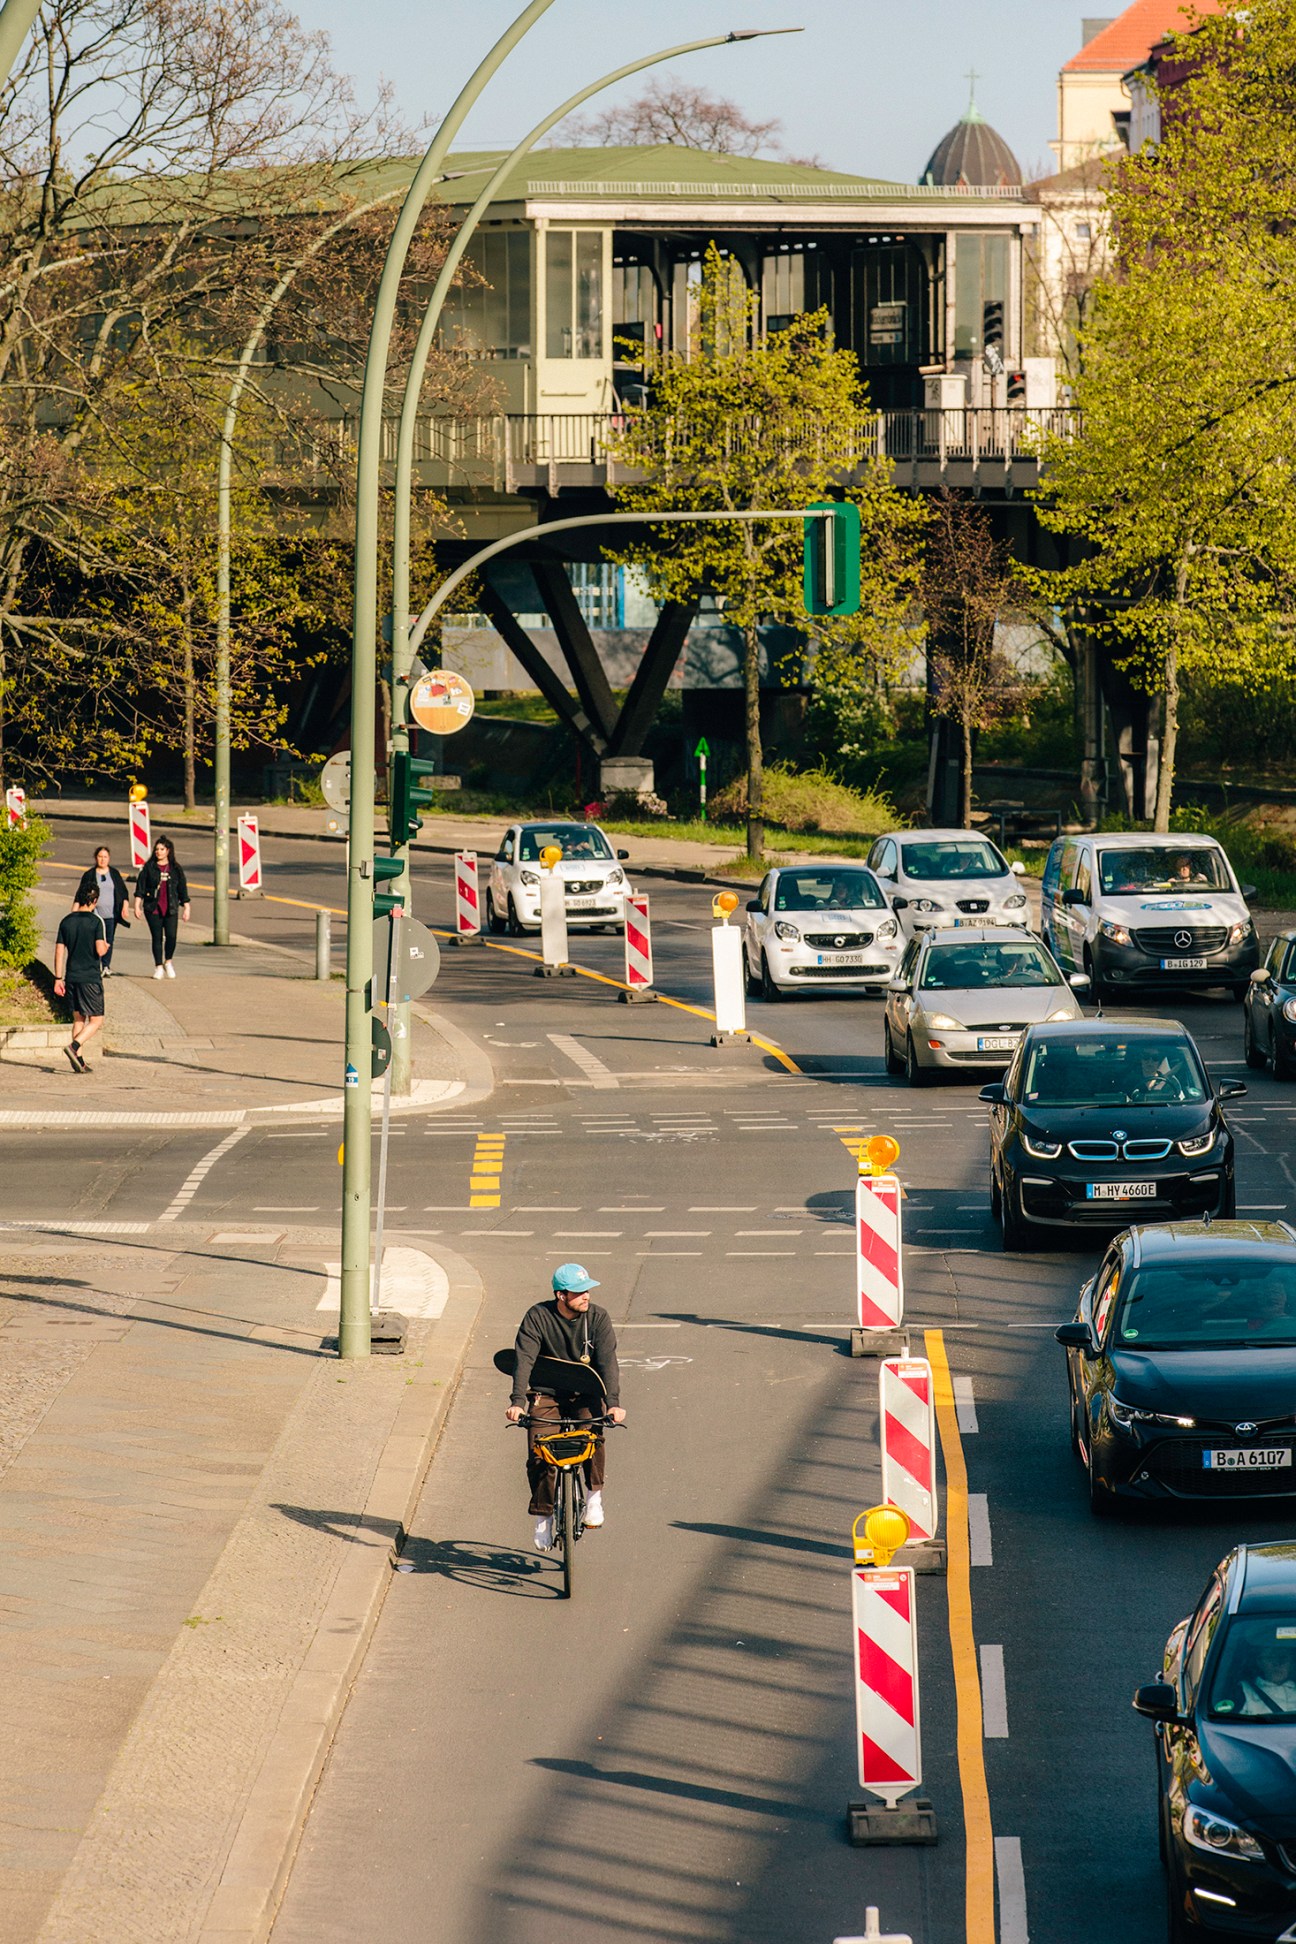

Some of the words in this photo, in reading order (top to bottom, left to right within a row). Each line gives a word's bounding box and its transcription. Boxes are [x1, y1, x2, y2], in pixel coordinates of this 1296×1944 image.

[1167, 960, 1173, 968] B
[1190, 960, 1203, 968] 129
[1094, 1185, 1101, 1196] M
[1107, 1185, 1120, 1196] HY
[1122, 1184, 1155, 1195] 4660E
[1217, 1452, 1226, 1465] B
[1237, 1452, 1245, 1465] A
[1249, 1450, 1285, 1465] 6107
